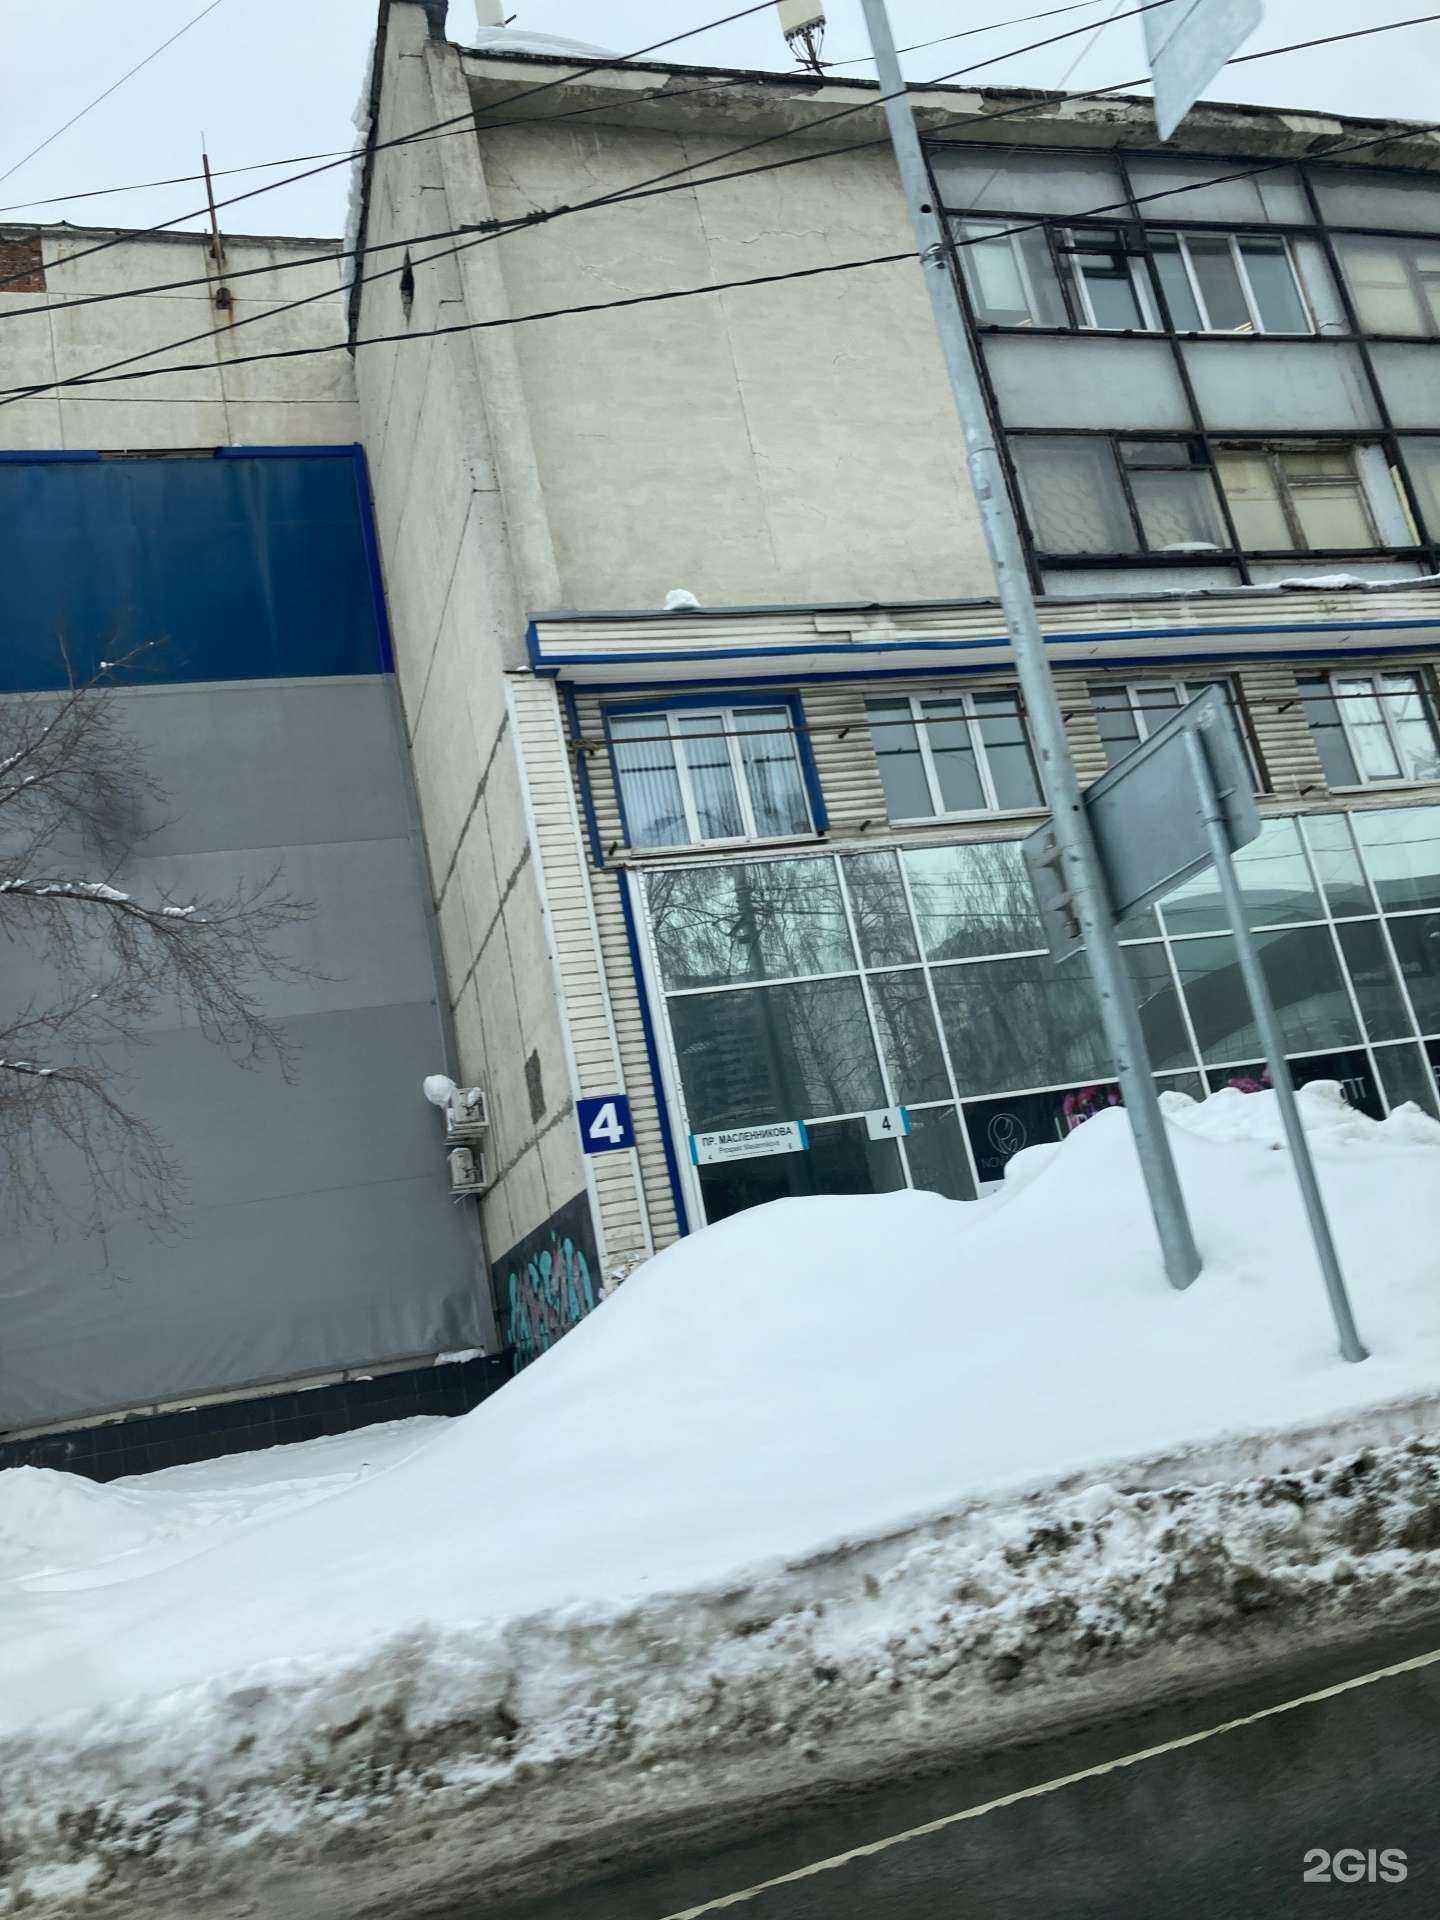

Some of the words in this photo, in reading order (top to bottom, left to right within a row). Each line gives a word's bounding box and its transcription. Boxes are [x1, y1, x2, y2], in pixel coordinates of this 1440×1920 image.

[589, 1103, 624, 1143] 4
[882, 1115, 891, 1130] 4
[702, 1136, 717, 1147] ПР.
[718, 1127, 793, 1145] МАСЛЕННИКОВА
